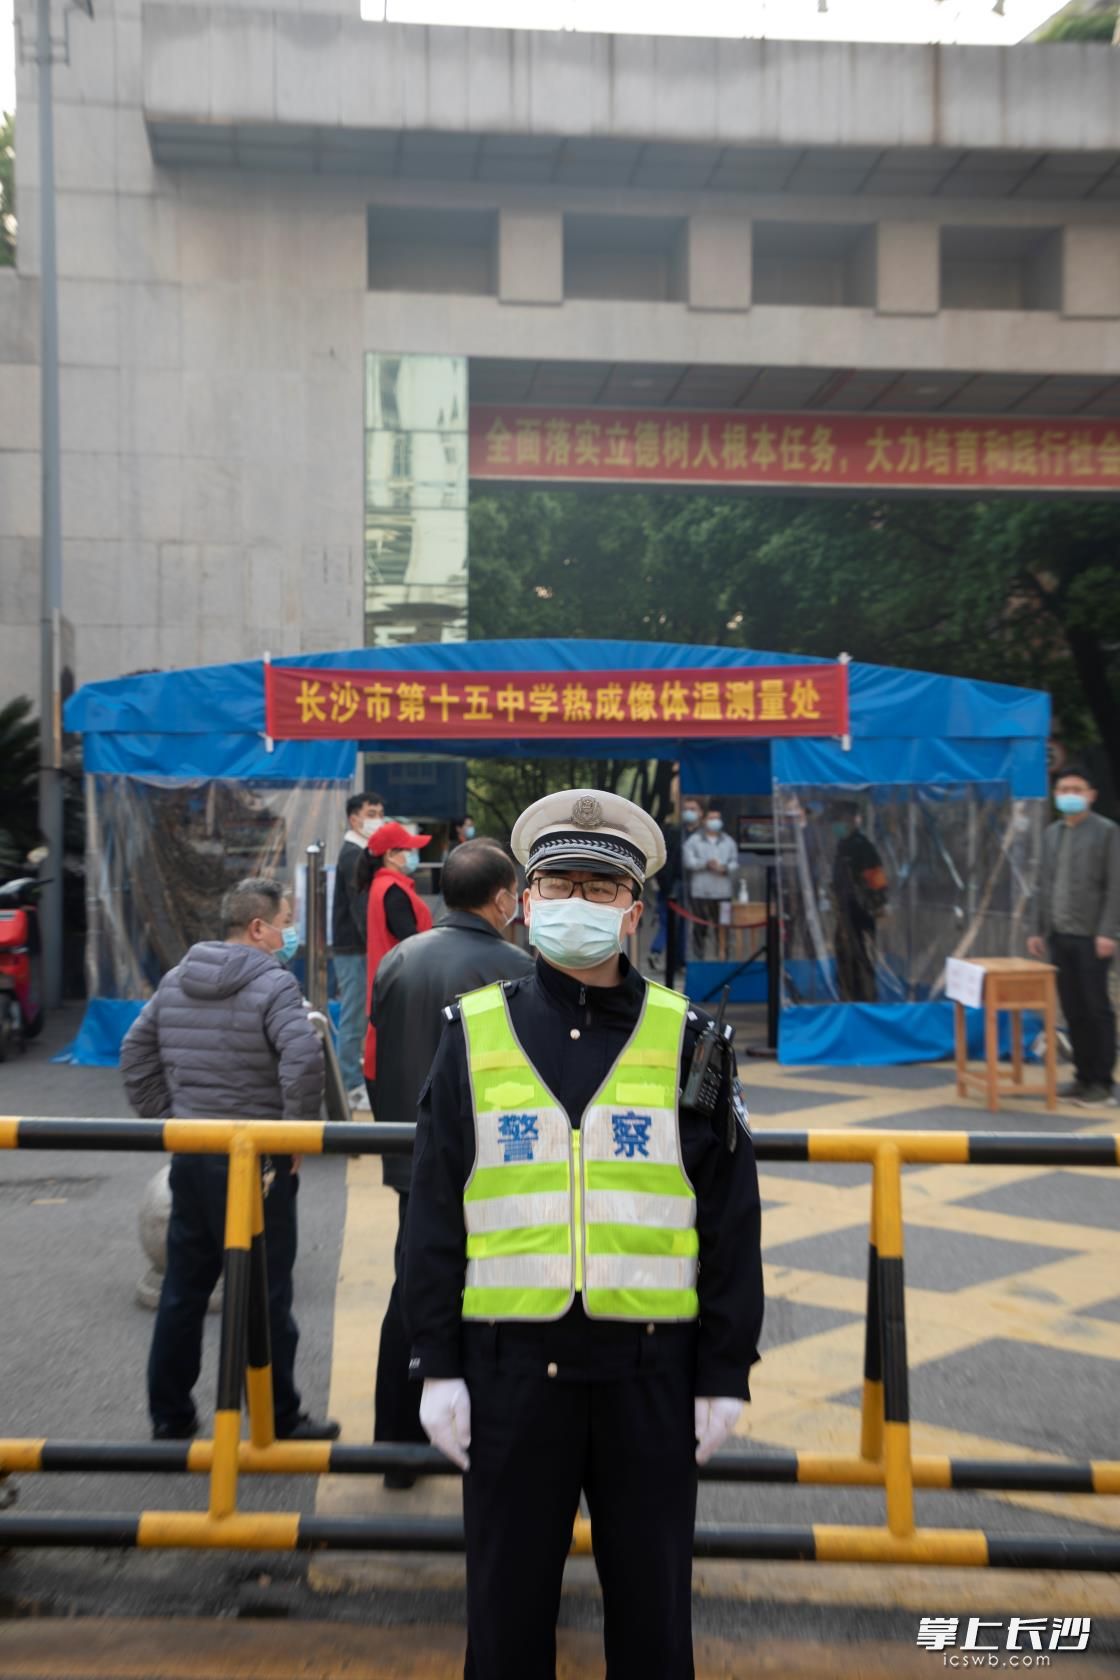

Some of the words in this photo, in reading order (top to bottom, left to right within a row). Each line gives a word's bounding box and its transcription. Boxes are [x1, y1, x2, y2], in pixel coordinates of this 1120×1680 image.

[296, 680, 821, 723] 长沙市第十五中学热成像体温测量处
